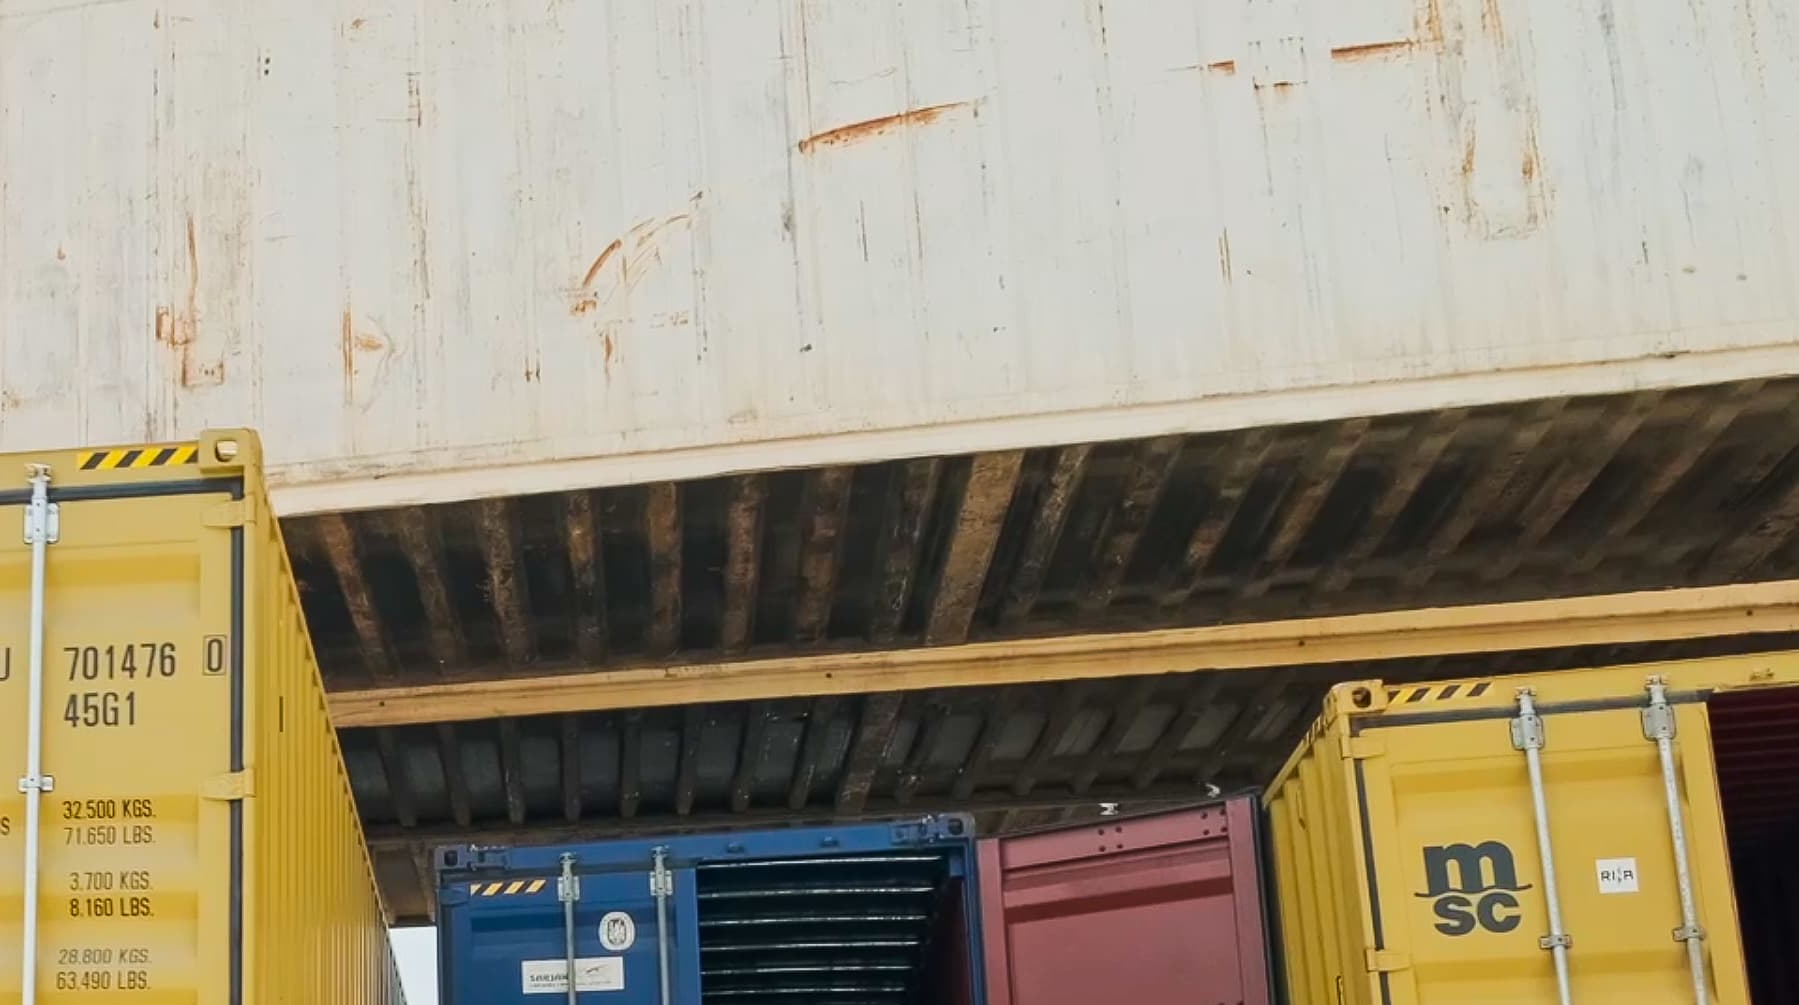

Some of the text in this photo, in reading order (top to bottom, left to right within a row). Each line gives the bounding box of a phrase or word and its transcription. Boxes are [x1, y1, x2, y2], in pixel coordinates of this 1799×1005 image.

[63, 643, 176, 681] 701476
[208, 639, 223, 672] 0
[64, 691, 135, 727] 45G1
[63, 800, 116, 819] 32.500
[122, 799, 156, 818] KGS.
[64, 825, 156, 846] 71.650 LBS.
[69, 871, 154, 891] 3.700 KGS.
[69, 898, 113, 918] 8.160
[120, 897, 155, 917] LBS.
[58, 948, 152, 964] 28.800 KGS.
[56, 970, 111, 990] 63.490
[117, 970, 151, 989] LBS.
